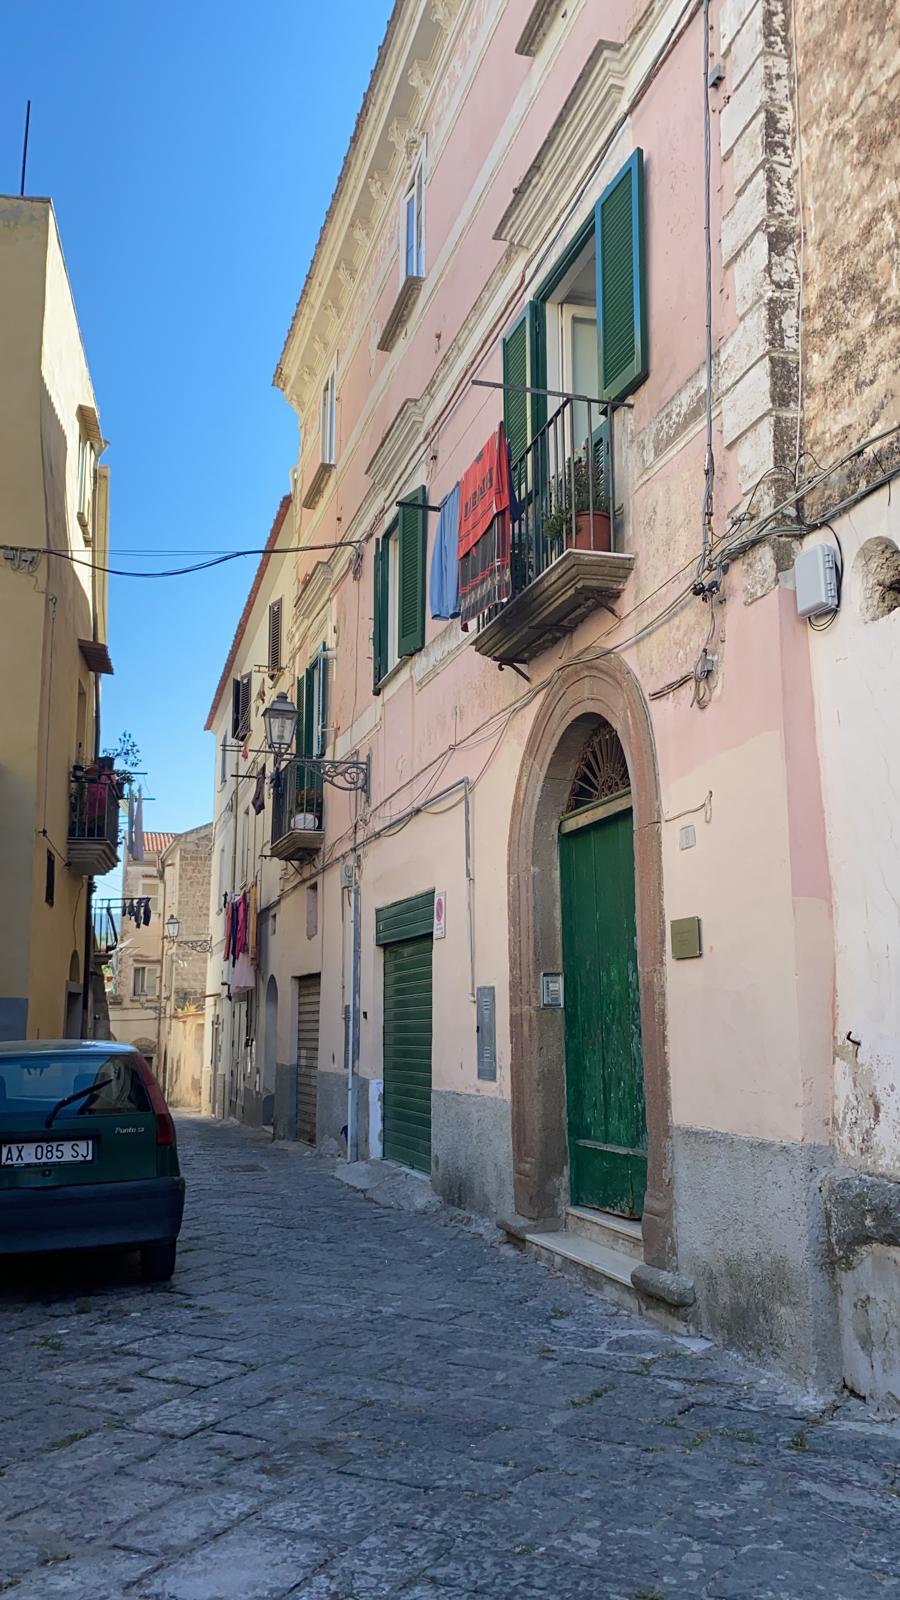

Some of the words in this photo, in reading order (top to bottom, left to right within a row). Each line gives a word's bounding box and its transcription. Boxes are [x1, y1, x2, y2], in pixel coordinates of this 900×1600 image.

[6, 1145, 24, 1162] AX
[35, 1144, 64, 1160] 085
[71, 1141, 89, 1159] SJ
